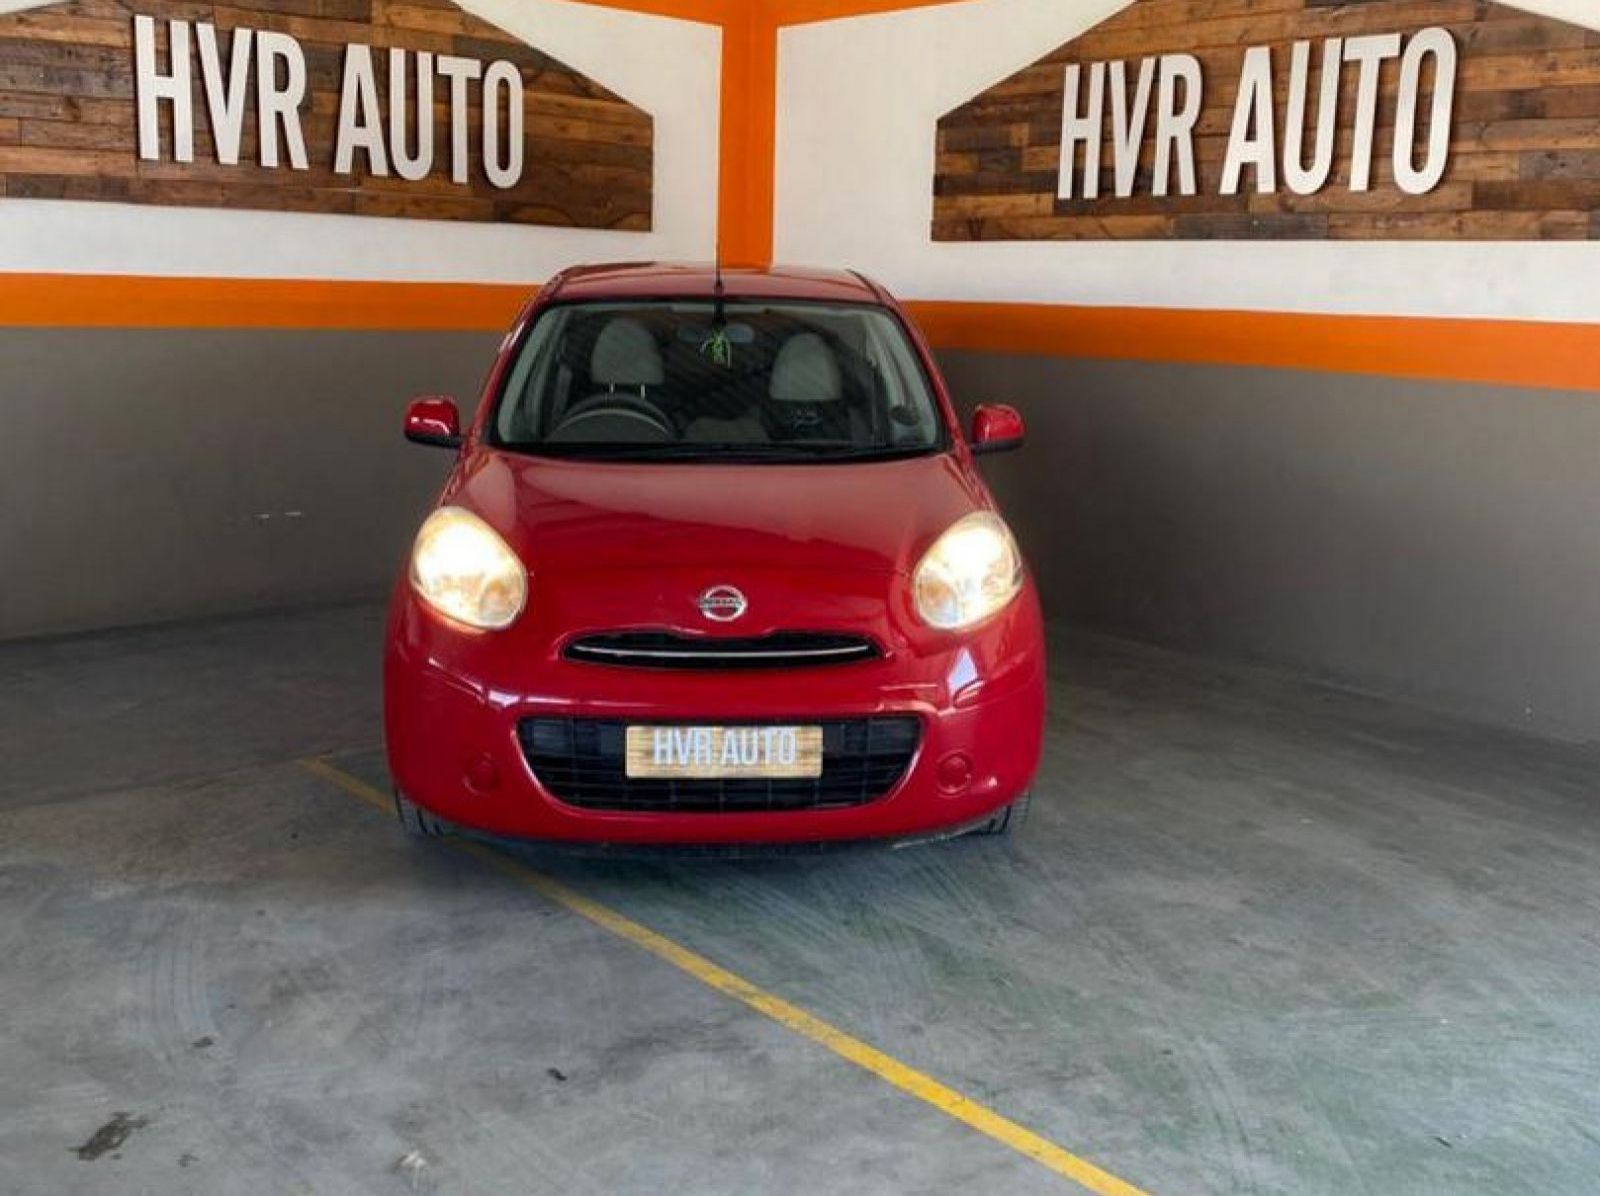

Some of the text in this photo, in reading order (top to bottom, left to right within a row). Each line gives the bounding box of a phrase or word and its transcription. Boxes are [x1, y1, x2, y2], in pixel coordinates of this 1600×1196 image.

[135, 15, 524, 189] HVR AUTO
[1057, 27, 1458, 200] HVR AUTO
[653, 727, 796, 765] HVR AUTO
